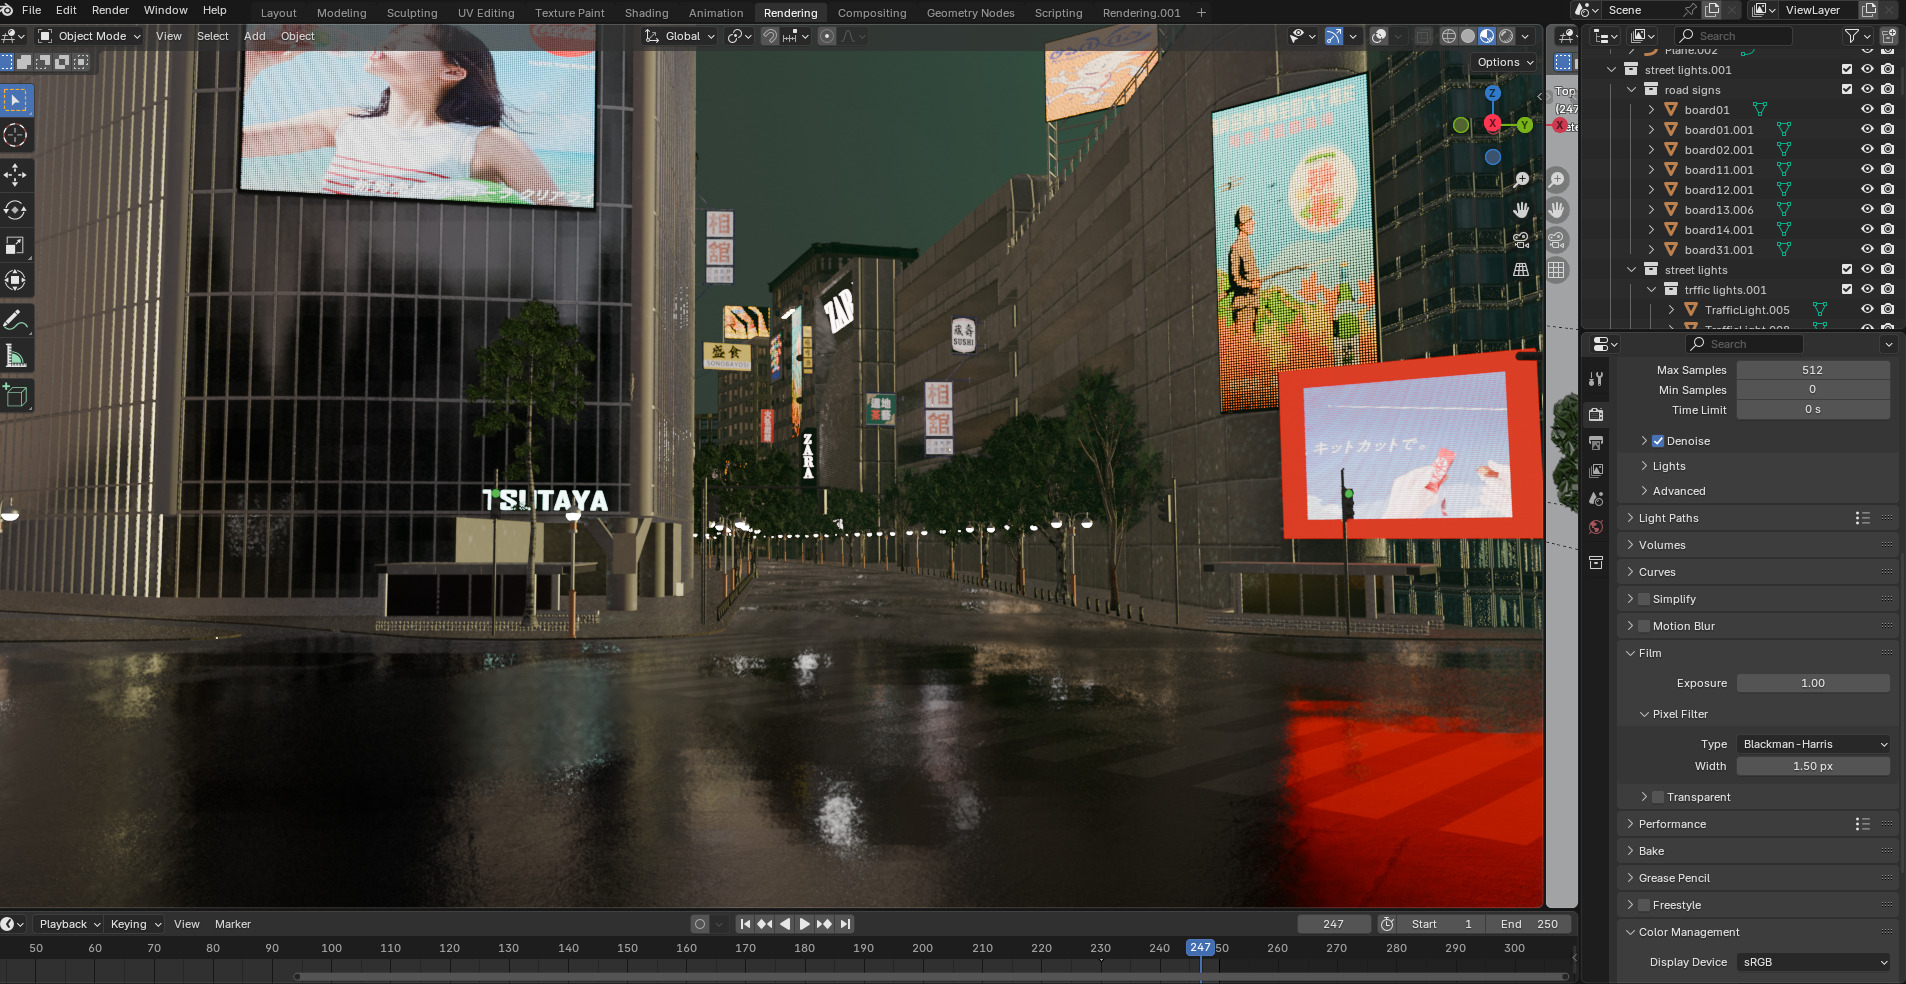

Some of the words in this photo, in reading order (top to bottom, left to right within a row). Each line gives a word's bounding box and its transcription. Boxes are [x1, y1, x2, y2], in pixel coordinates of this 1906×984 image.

[22, 5, 42, 15] File
[56, 5, 77, 15] Edit
[92, 5, 130, 15] Render
[143, 5, 189, 15] Window
[203, 5, 227, 17] Help
[261, 8, 297, 20] Layout
[317, 8, 367, 20] Modeling
[387, 8, 438, 20] Sculpting
[458, 8, 474, 18] UV
[477, 8, 515, 20] Editing
[534, 8, 576, 18] Texture
[578, 8, 605, 18] Paint
[625, 8, 669, 20] Shading
[688, 8, 744, 18] Animation
[764, 8, 818, 20] Rendering
[837, 8, 907, 20] Compositing
[927, 8, 979, 20] Geometry
[981, 8, 1015, 18] Nodes
[1035, 8, 1083, 20] Scripting
[1103, 8, 1181, 20] Rendering.001
[1609, 5, 1642, 15] Scene
[1785, 5, 1841, 17] ViewLayer
[59, 31, 93, 43] Object
[96, 31, 127, 41] Mode
[155, 31, 183, 41] View
[197, 31, 229, 41] Select
[244, 31, 266, 41] Add
[281, 31, 315, 43] Object
[666, 31, 701, 41] Global
[1700, 31, 1736, 41] Search
[1478, 57, 1520, 69] Options
[1645, 65, 1675, 75] street
[1678, 65, 1732, 77] lights.001
[1555, 86, 1576, 99] Top
[1665, 85, 1689, 95] road
[1692, 85, 1721, 97] signs
[1685, 105, 1730, 115] board01
[1685, 125, 1754, 135] board01.001
[1685, 145, 1754, 155] board02.001
[1685, 165, 1754, 175] board11.001
[1685, 185, 1754, 195] board12.001
[1685, 205, 1754, 215] board13.006
[1685, 225, 1754, 235] board14.001
[1685, 245, 1754, 255] board31.001
[1665, 265, 1695, 275] street
[1698, 265, 1728, 277] lights
[1684, 285, 1711, 295] trffic
[1713, 285, 1767, 297] lights.001
[1704, 305, 1790, 317] TrafficLight.005
[953, 338, 974, 346] SUSHI
[1711, 339, 1747, 349] Search
[1657, 365, 1680, 375] Max
[1682, 365, 1727, 377] Samples
[1802, 365, 1823, 375] 512
[1659, 385, 1679, 395] Min
[1682, 385, 1727, 397] Samples
[1809, 384, 1817, 394] 0
[1671, 405, 1699, 415] Time
[1701, 405, 1727, 415] Limit
[1805, 404, 1813, 414] 0
[1815, 406, 1821, 414] s
[1667, 436, 1711, 446] Denoise
[802, 433, 815, 480] ZARA
[1653, 461, 1686, 473] Lights
[1652, 486, 1706, 496] Advanced
[482, 488, 608, 512] TSUTAYA
[1639, 513, 1666, 525] Light
[1669, 513, 1699, 523] Paths
[1638, 540, 1686, 550] Volumes
[1639, 567, 1676, 577] Curves
[1653, 594, 1697, 606] Simplify
[1653, 621, 1691, 631] Motion
[1694, 621, 1716, 631] Blur
[1639, 648, 1662, 658] Film
[1677, 678, 1728, 690] Exposure
[1801, 678, 1826, 688] 1.00
[1653, 709, 1679, 719] Pixel
[1681, 709, 1709, 719] Filter
[1700, 739, 1728, 751] Type
[1744, 739, 1833, 749] Blackman-Harris
[1694, 761, 1727, 771] Width
[1793, 761, 1817, 771] 1.50
[1820, 763, 1833, 773] px
[1666, 792, 1731, 804] Transparent
[1639, 819, 1707, 829] Performance
[1639, 846, 1665, 856] Bake
[1639, 873, 1676, 883] Grease
[1678, 873, 1711, 883] Pencil
[1653, 900, 1702, 912] Freestyle
[40, 919, 88, 931] Playback
[111, 919, 147, 931] Keying
[173, 919, 201, 929] View
[215, 919, 252, 929] Marker
[1323, 919, 1344, 929] 247
[1412, 919, 1437, 929] Start
[1465, 919, 1472, 929] 1
[1501, 919, 1522, 929] End
[1537, 919, 1559, 929] 250
[1639, 927, 1669, 937] Color
[1671, 927, 1740, 939] Management
[29, 943, 44, 953] 50
[88, 943, 103, 953] 60
[147, 943, 162, 953] 70
[206, 943, 221, 953] 80
[265, 943, 280, 953] 90
[321, 943, 343, 953] 100
[380, 943, 402, 953] 110
[439, 943, 461, 953] 120
[498, 943, 520, 953] 130
[558, 943, 580, 953] 140
[617, 943, 639, 953] 150
[676, 943, 698, 953] 160
[735, 943, 757, 953] 170
[794, 943, 816, 953] 180
[853, 943, 875, 953] 190
[912, 943, 934, 953] 200
[972, 943, 994, 953] 210
[1031, 943, 1053, 953] 220
[1090, 943, 1112, 953] 230
[1149, 943, 1171, 953] 240
[1190, 942, 1212, 953] 247
[1215, 943, 1230, 953] 50
[1267, 943, 1289, 953] 260
[1326, 943, 1348, 953] 270
[1386, 943, 1408, 953] 280
[1445, 943, 1467, 953] 290
[1504, 943, 1526, 953] 300
[1650, 957, 1690, 969] Display
[1692, 957, 1728, 967] Device
[1744, 957, 1773, 967] sRGB
